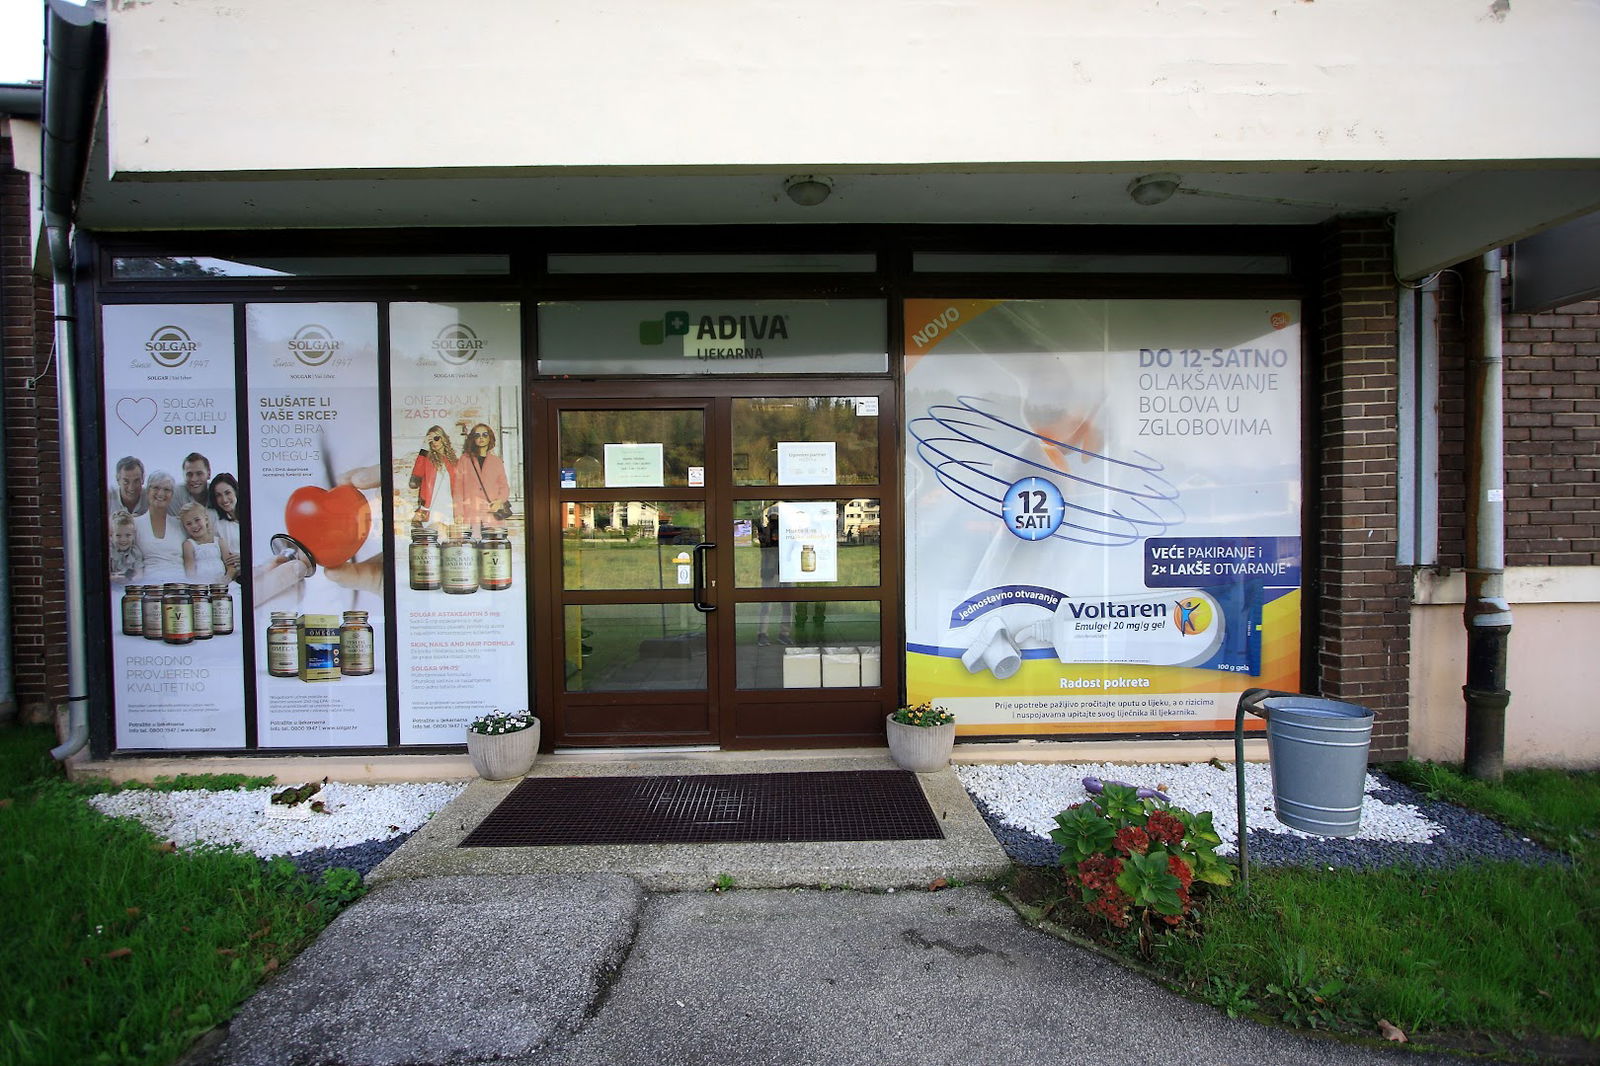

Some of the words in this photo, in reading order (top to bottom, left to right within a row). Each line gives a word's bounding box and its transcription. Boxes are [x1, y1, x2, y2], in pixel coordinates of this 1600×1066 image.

[697, 315, 788, 340] ADIVA
[912, 307, 960, 348] NOVO
[145, 342, 197, 351] SOLGAR
[288, 341, 340, 350] SOLGAR
[432, 340, 483, 349] SOLGAR
[697, 348, 763, 361] LJEKARNA
[1139, 349, 1173, 368] DO
[1180, 348, 1288, 368] 12-SATNO
[331, 358, 352, 367] 1947
[1139, 369, 1279, 394] OLAKŠAVANJE
[163, 399, 214, 408] SOLGAR
[260, 395, 316, 408] SLUŠATE
[320, 397, 331, 407] LI
[404, 395, 431, 406] ONE
[435, 393, 478, 405] ZNAJU
[1139, 396, 1220, 413] BOLOVA
[1227, 396, 1240, 413] U
[164, 412, 180, 422] ZA
[185, 411, 226, 422] CIJELU
[260, 408, 294, 421] VAŠE
[298, 410, 338, 421] SRCE?
[404, 407, 448, 419] ZAŠTO
[164, 425, 217, 435] OBITELJ
[261, 424, 290, 435] ONO
[294, 424, 325, 434] BIRA
[1138, 419, 1272, 436] ZGLOBOVIMA
[261, 438, 312, 448] SOLGAR
[261, 450, 320, 461] OMEGU-3
[1018, 490, 1048, 514] 12
[1015, 515, 1051, 529] SATI
[1151, 545, 1185, 559] VEĆE
[1188, 547, 1256, 560] PAKIRANJE
[1258, 546, 1263, 558] i
[1170, 561, 1211, 575] LAKŠE
[959, 591, 1013, 620] Jednostavno
[1014, 590, 1059, 605] otvaranje
[1068, 602, 1167, 619] Voltaren
[1075, 622, 1111, 632] Emulgel
[1113, 622, 1124, 630] 20
[1126, 622, 1150, 632] mg/g
[1151, 620, 1166, 630] gel
[126, 656, 192, 666] PRIRODNO
[1235, 664, 1249, 672] gela
[126, 669, 210, 680] PROVJERENO
[127, 682, 205, 693] KVALITETNO
[1060, 678, 1101, 689] Radost
[1103, 677, 1150, 690] pokreta
[995, 702, 1012, 710] Prije
[1014, 702, 1048, 711] upotrebe
[1050, 701, 1079, 709] pažljivo
[1080, 700, 1116, 709] pročitajte
[1117, 700, 1140, 708] uputu
[1148, 700, 1171, 708] lijeku,
[1016, 711, 1066, 720] nuspojavama
[1067, 711, 1096, 719] upitajte
[1117, 710, 1148, 718] liječnika
[1158, 709, 1198, 717] ljekarnika.
